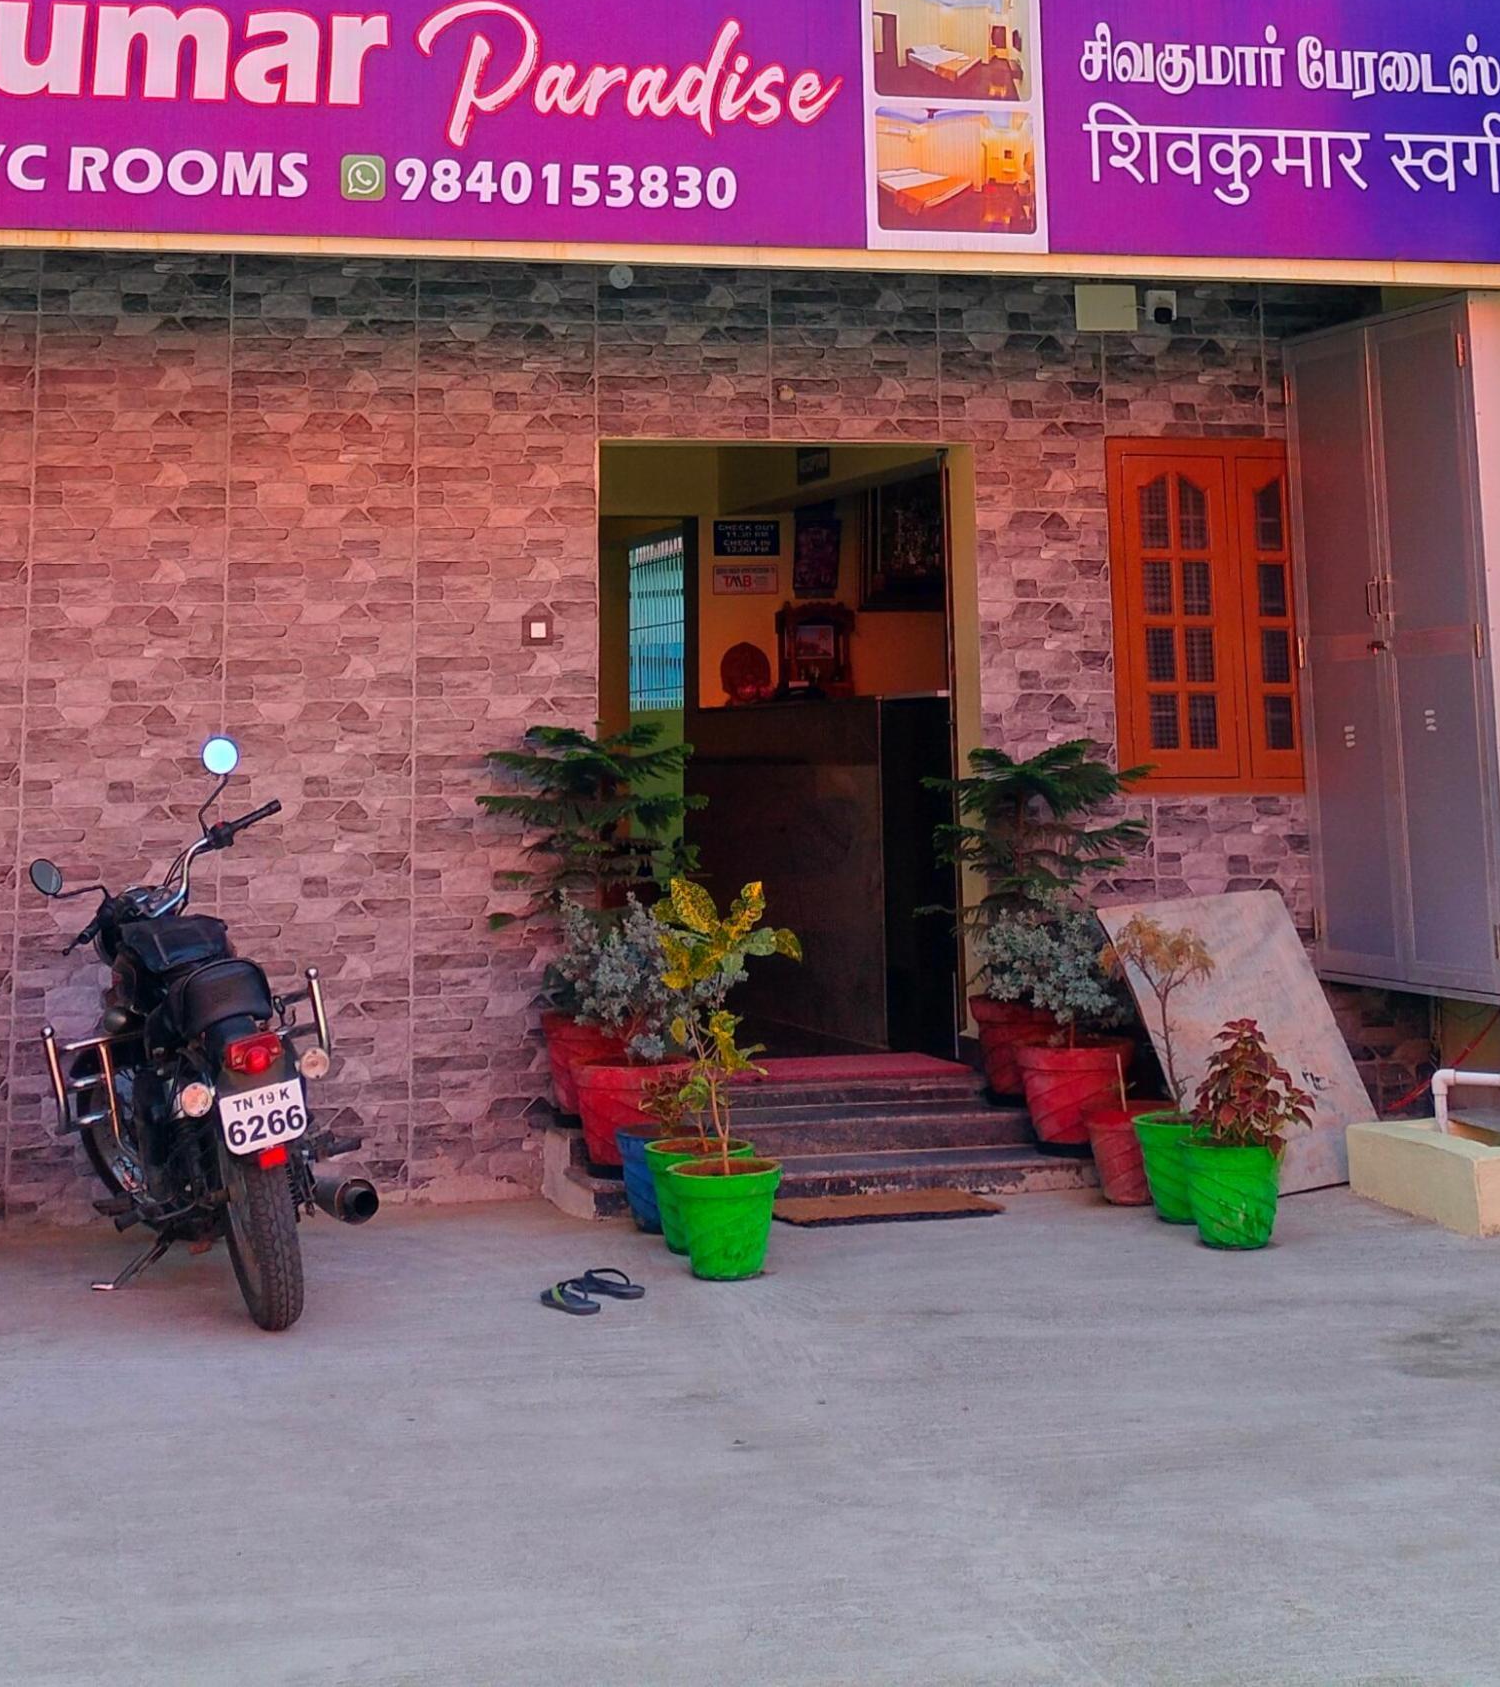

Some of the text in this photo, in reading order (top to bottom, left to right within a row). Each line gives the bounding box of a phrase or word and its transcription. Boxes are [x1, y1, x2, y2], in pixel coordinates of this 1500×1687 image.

[1080, 22, 1285, 95] சிவகுமார்
[68, 146, 308, 199] ROOMS
[1082, 101, 1371, 205] शिवकुमार
[395, 157, 737, 209] 9840153830
[227, 1104, 305, 1147] 6266
[233, 1087, 290, 1112] TN 19 K
